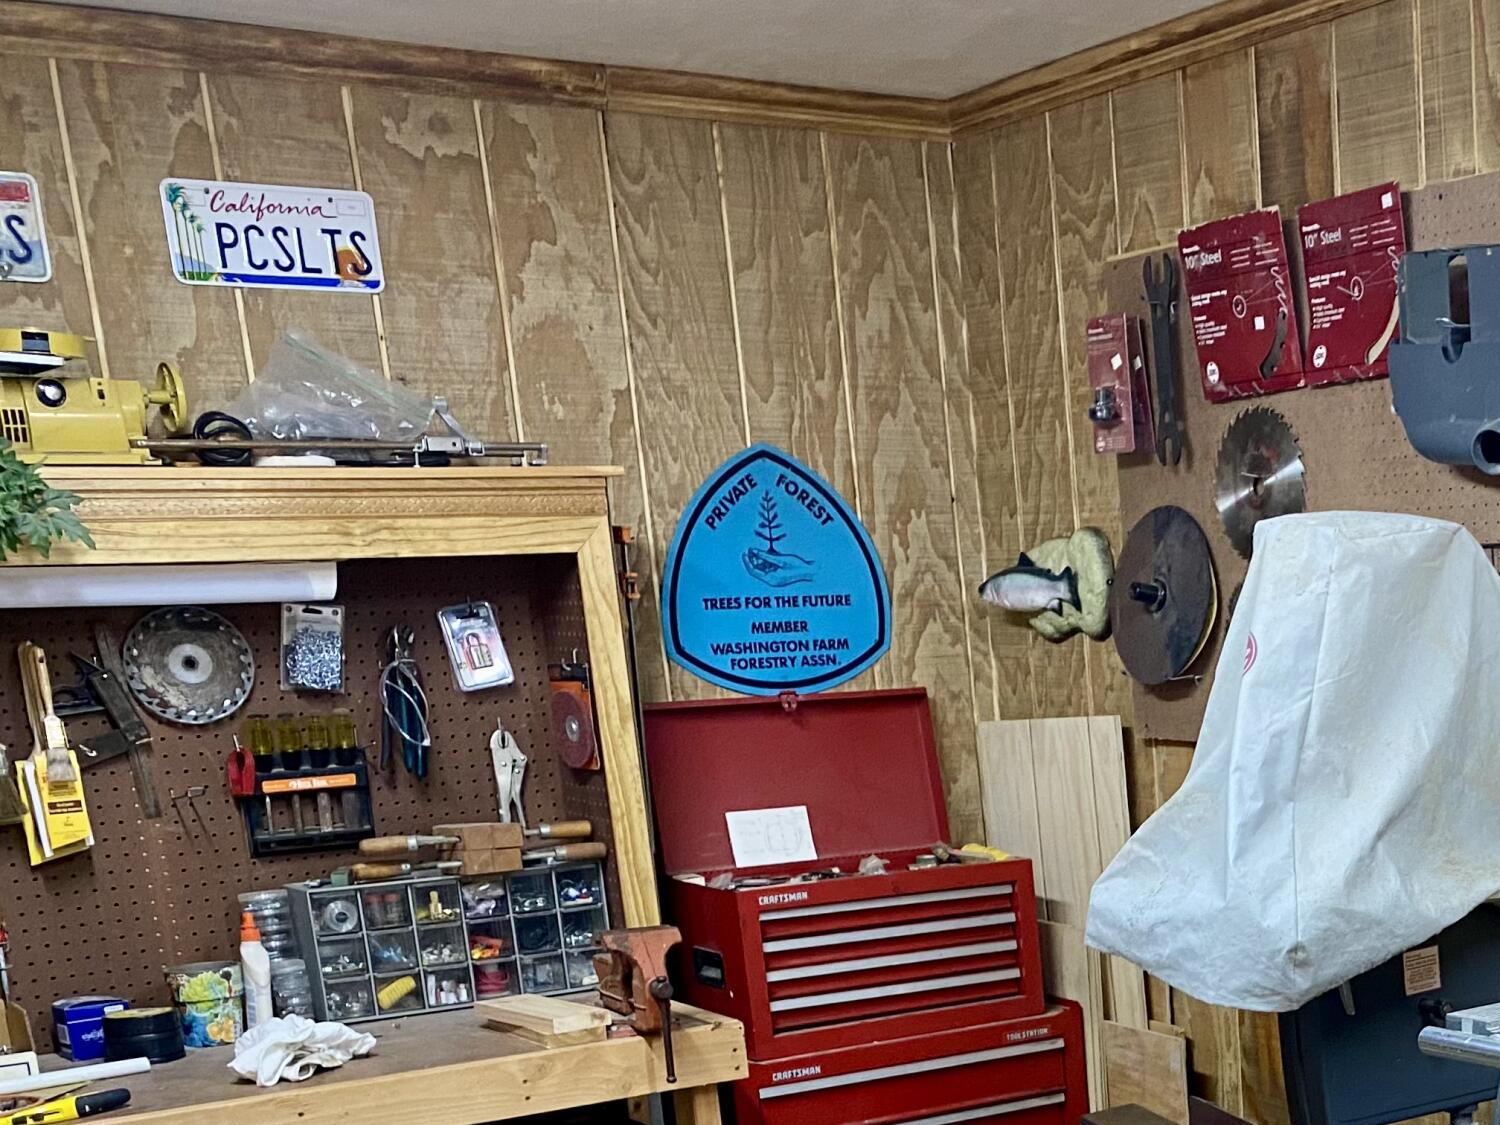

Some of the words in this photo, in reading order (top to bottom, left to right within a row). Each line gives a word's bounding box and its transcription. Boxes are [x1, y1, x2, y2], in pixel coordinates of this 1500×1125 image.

[210, 190, 337, 222] California
[1320, 228, 1342, 246] Steel
[215, 222, 373, 276] PCSLTS
[1200, 249, 1222, 267] Steel
[705, 473, 758, 531] PRIVATE
[775, 473, 835, 526] FOREST
[702, 597, 742, 610] TREES
[745, 596, 772, 609] FOR
[776, 595, 799, 608] THE
[802, 594, 852, 607] FUTURE
[751, 620, 809, 634] MEMBER
[710, 640, 809, 656] WASHINGTON
[813, 638, 850, 651] FARM
[730, 655, 797, 671] FORESTRY
[801, 654, 841, 667] ASSN.
[759, 891, 808, 906] CRAFTSMAN
[772, 1065, 821, 1082] CRAFTSMAN
